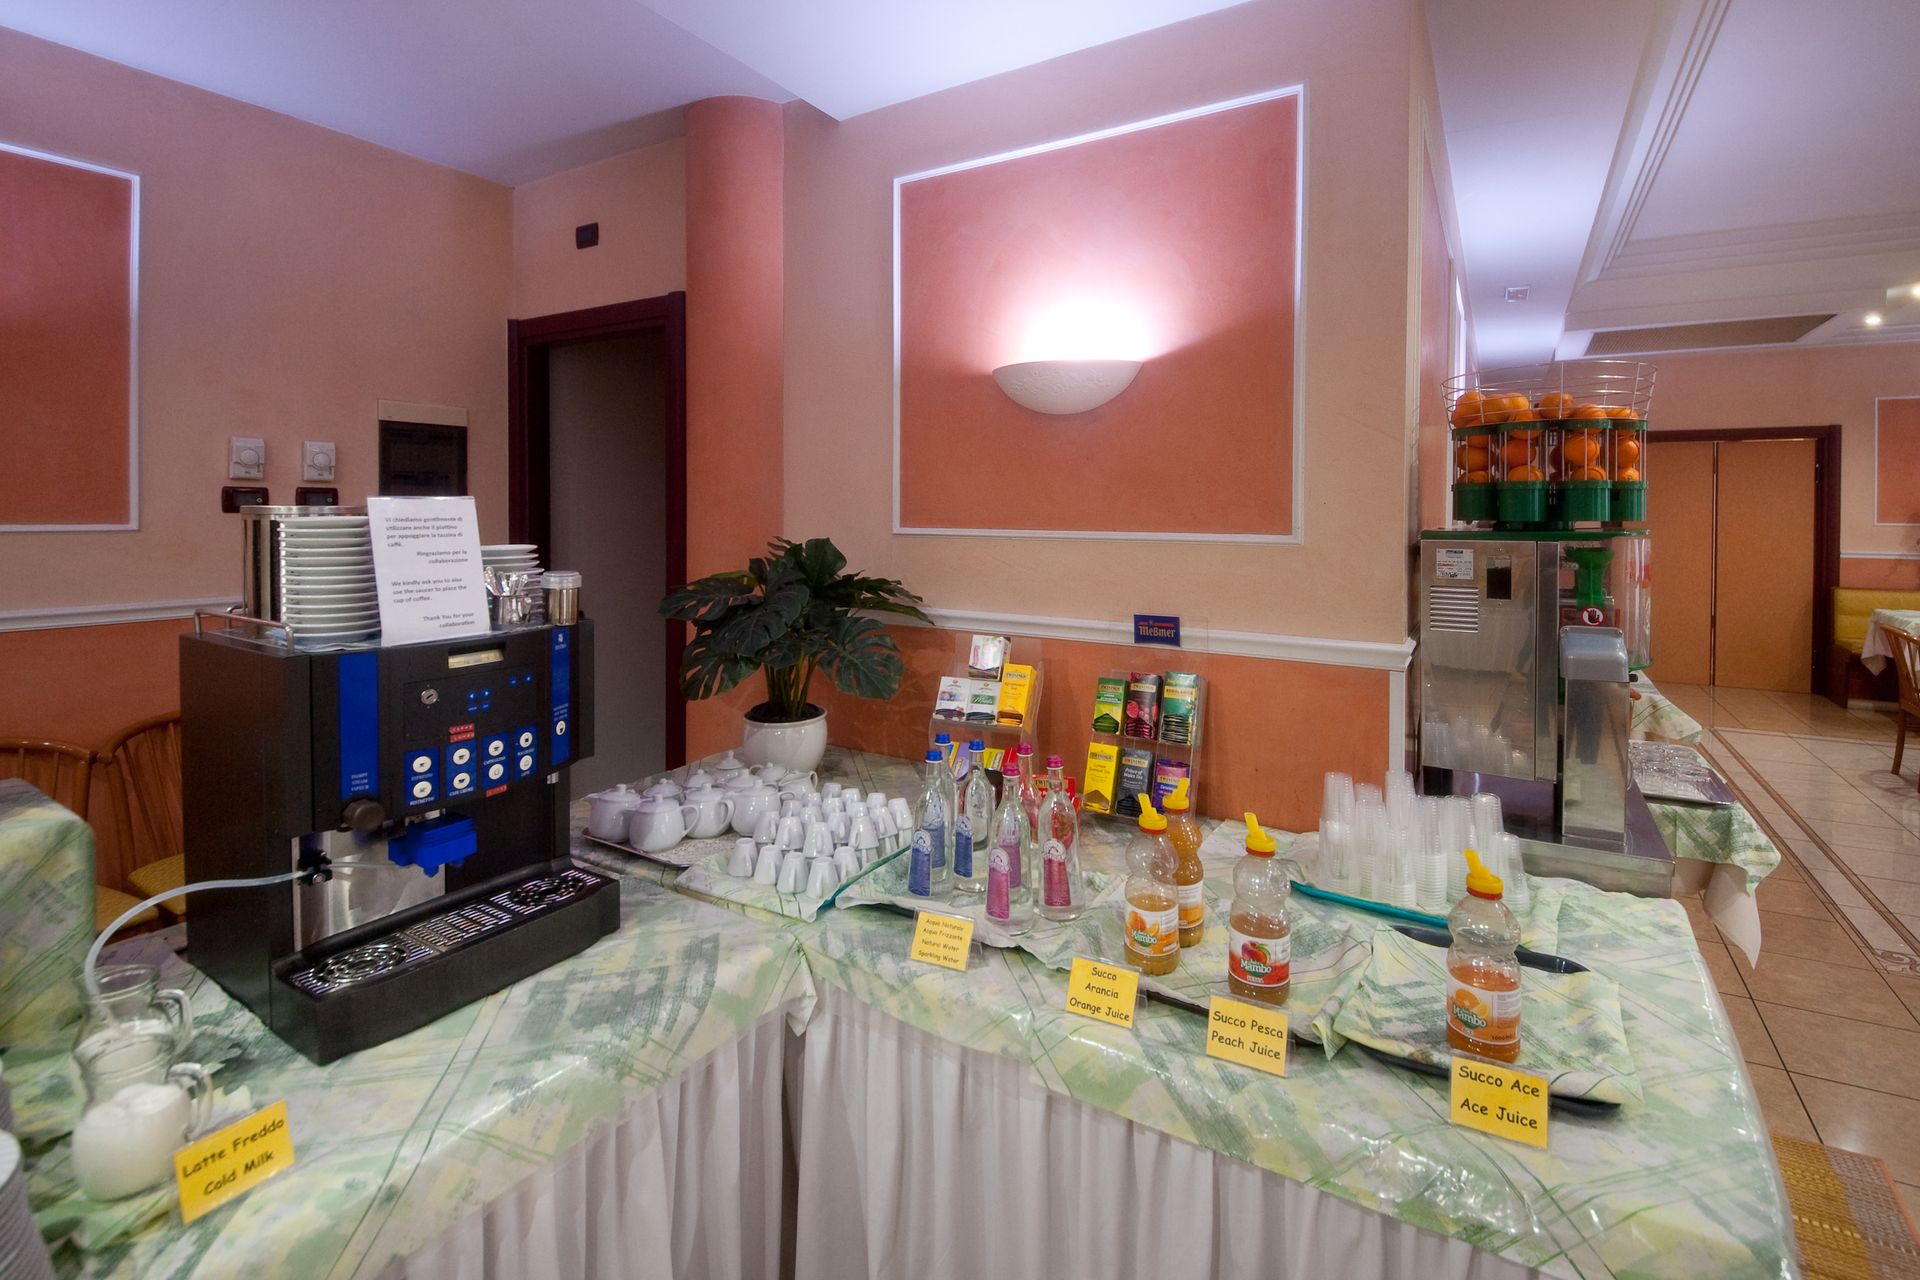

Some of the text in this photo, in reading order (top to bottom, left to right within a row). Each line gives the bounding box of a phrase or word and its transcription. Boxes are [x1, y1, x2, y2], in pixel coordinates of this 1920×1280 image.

[416, 550, 451, 558] Ringraziamo
[428, 557, 469, 565] collaborazione
[442, 585, 457, 593] place
[422, 614, 441, 622] Thank
[461, 611, 475, 619] your
[439, 620, 476, 629] collaboration
[925, 918, 964, 932] Acqua Naturale
[922, 927, 963, 941] Acqua Frizzante
[921, 938, 959, 952] Natural Water
[918, 949, 959, 963] Sparkling Water
[1091, 966, 1117, 981] Succo
[1240, 958, 1272, 974] Mambo
[1084, 982, 1119, 999] Arancia
[1069, 997, 1130, 1021] Orange Juice
[1453, 1005, 1487, 1028] Mambo
[1212, 1010, 1284, 1039] Succo Pesca
[1211, 1030, 1281, 1060] Peach Juice
[1458, 1065, 1540, 1097] Succo Ace
[1460, 1097, 1538, 1129] Ace Juice
[182, 1119, 285, 1179] Latte Freddo
[203, 1150, 275, 1196] Cold Milk
